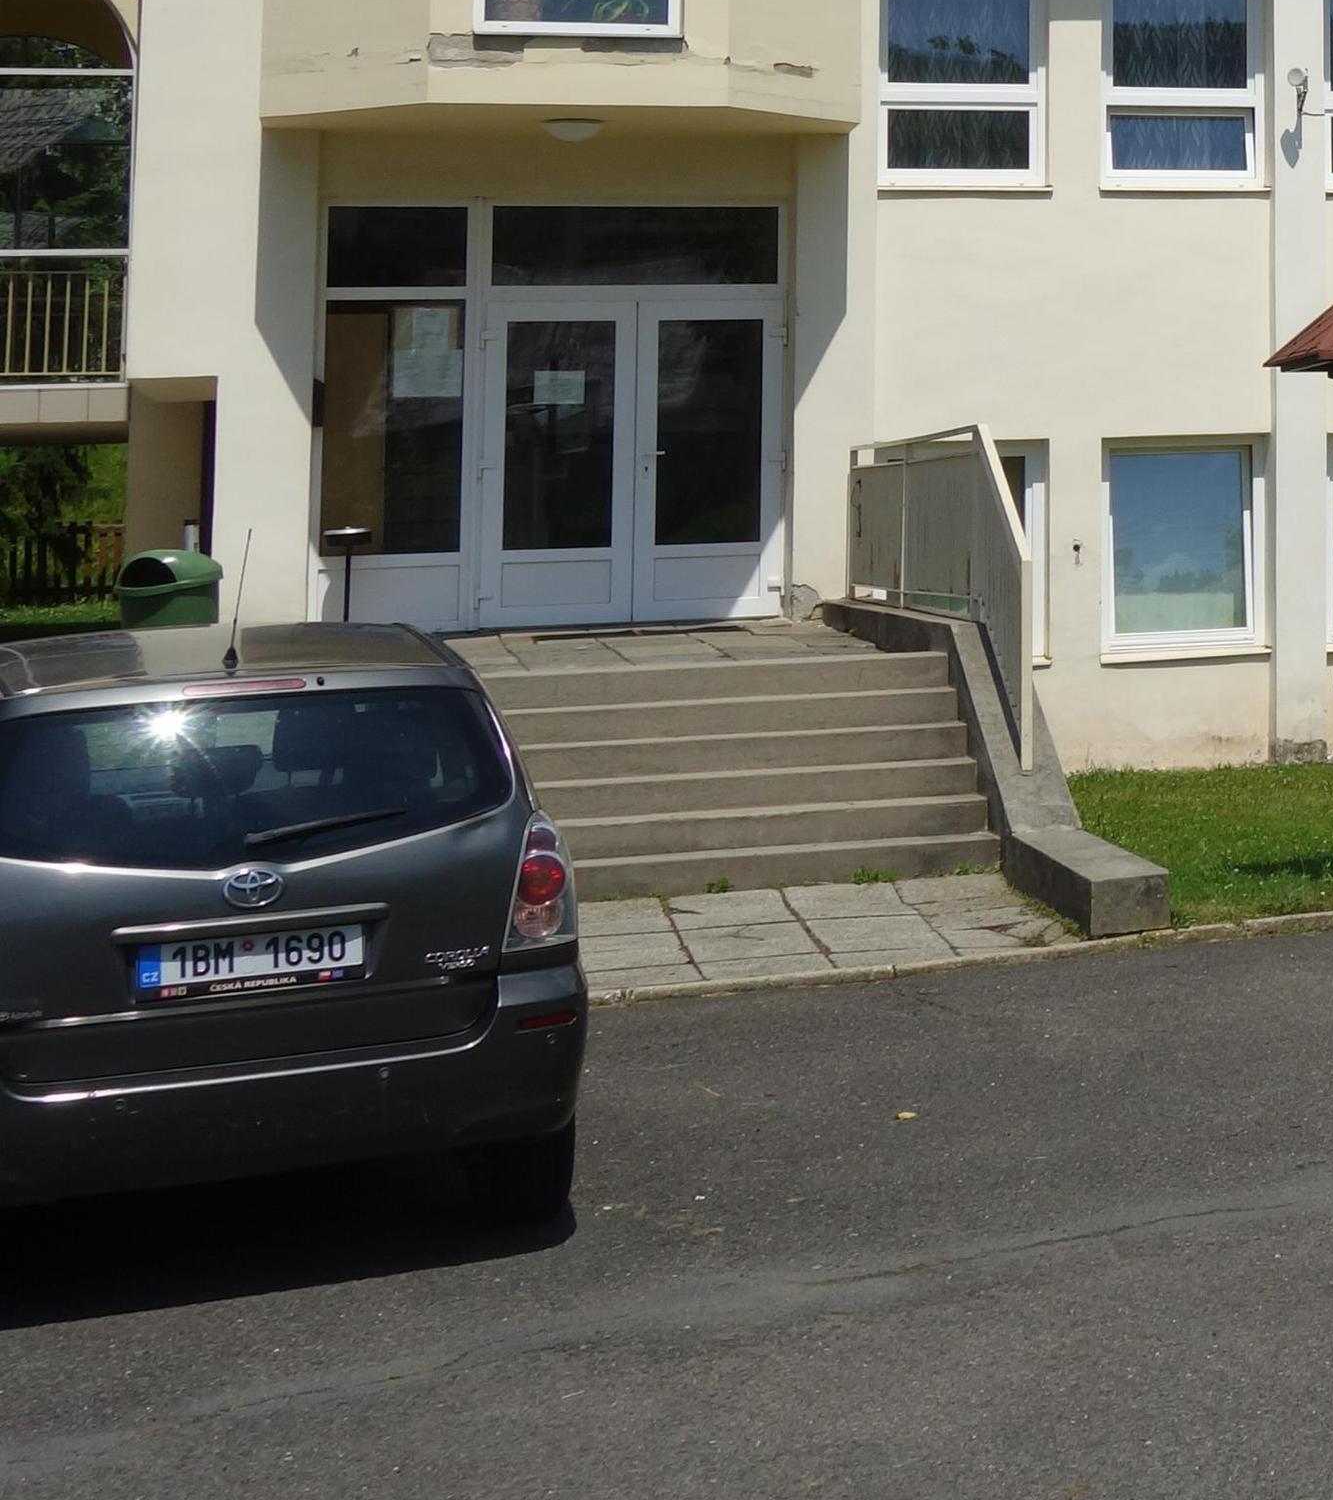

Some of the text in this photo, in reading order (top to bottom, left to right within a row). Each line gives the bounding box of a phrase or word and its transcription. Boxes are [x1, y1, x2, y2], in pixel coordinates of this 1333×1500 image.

[172, 930, 347, 978] 1BM 1690
[142, 971, 159, 984] CZ
[244, 976, 297, 988] REPUBLIKA
